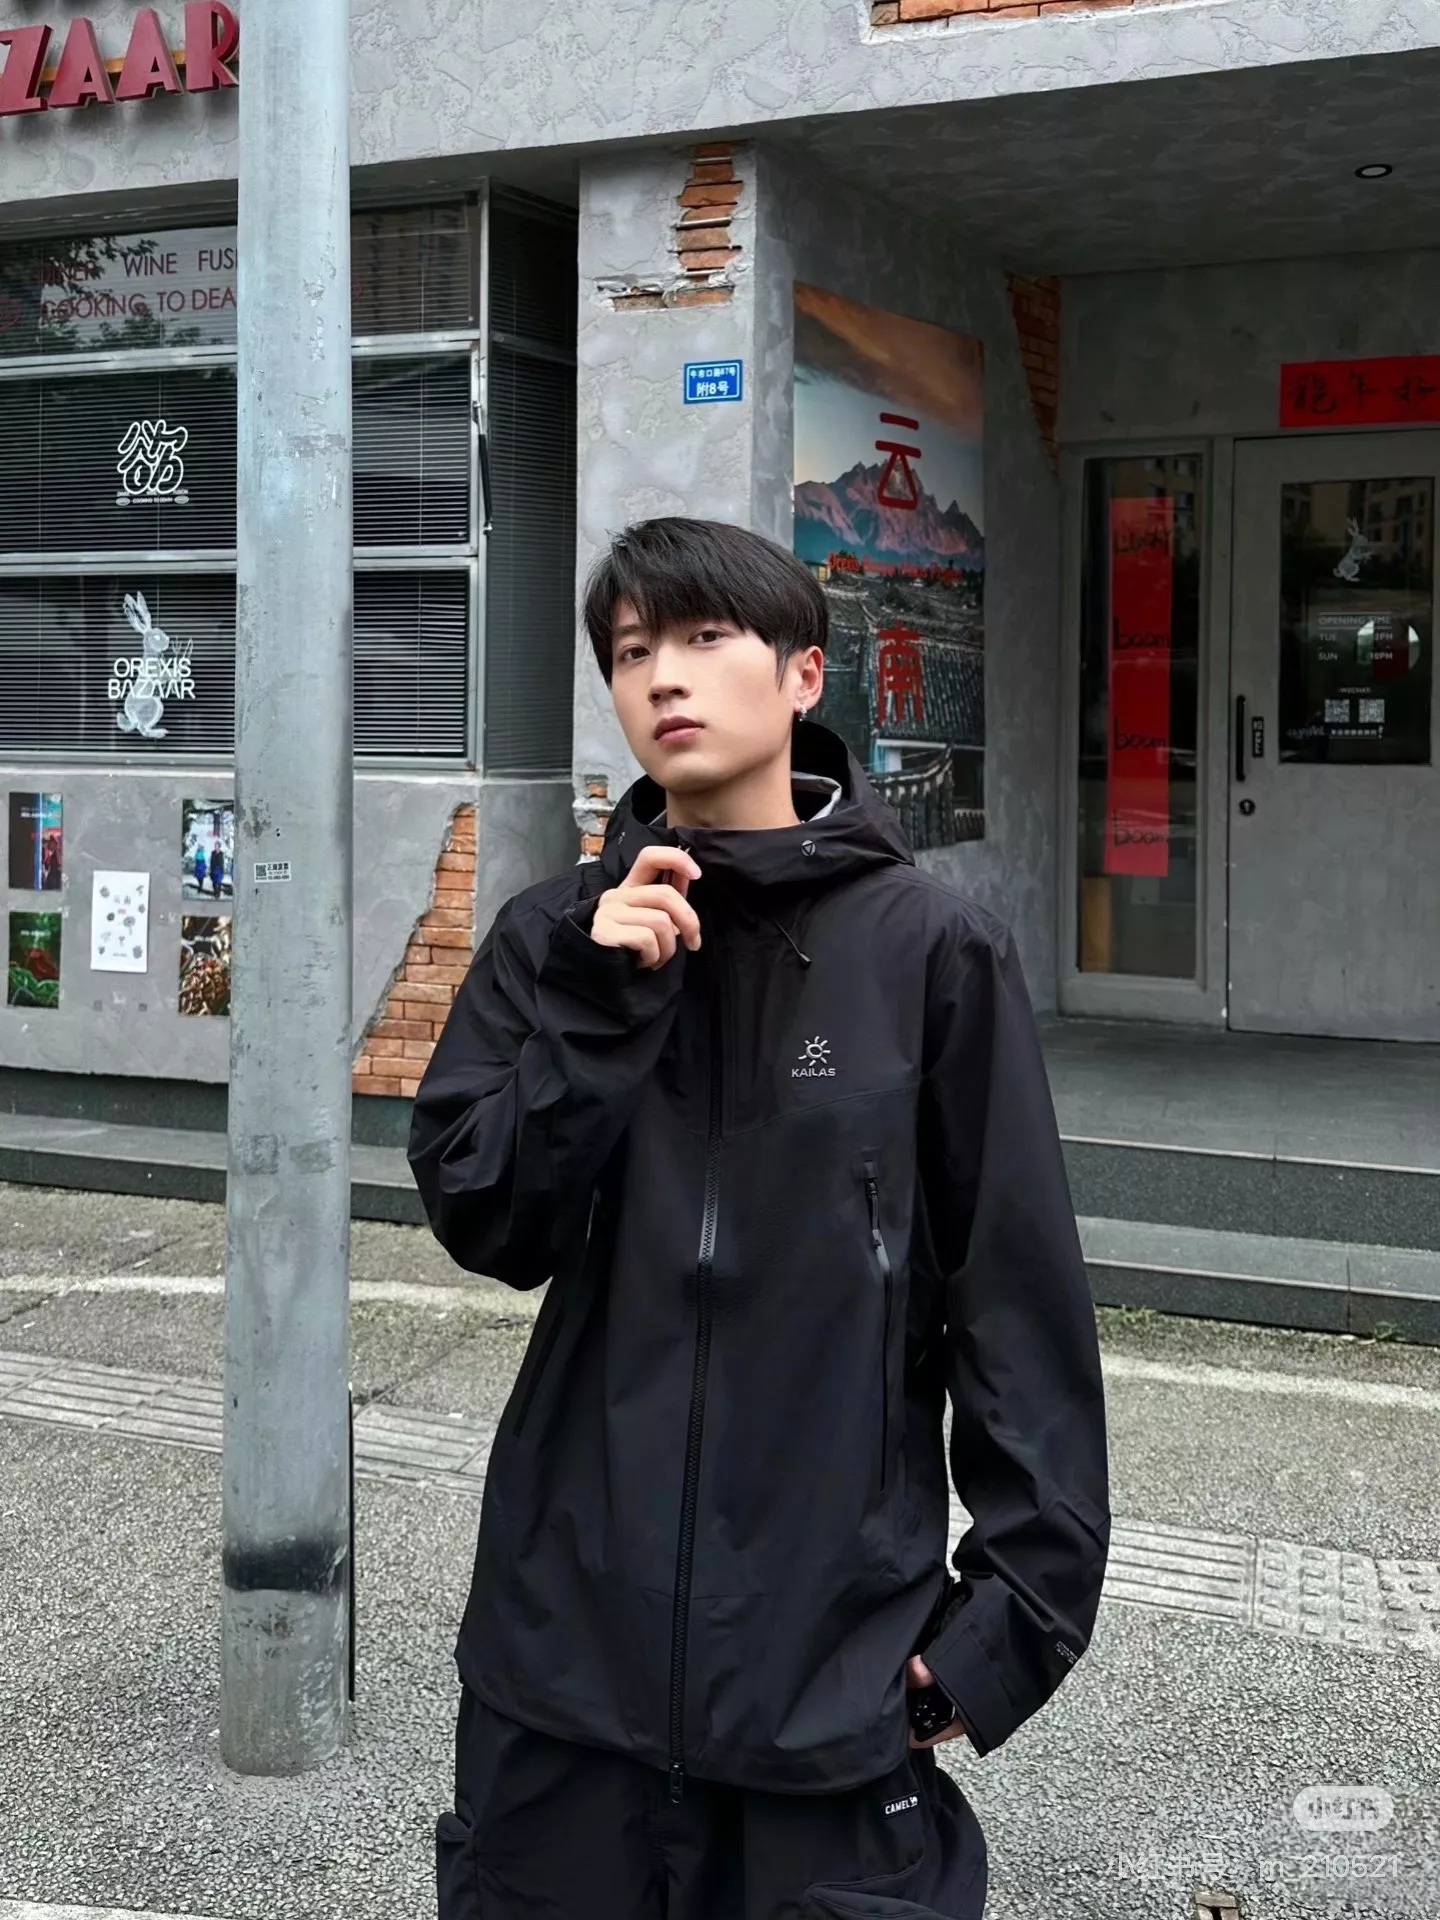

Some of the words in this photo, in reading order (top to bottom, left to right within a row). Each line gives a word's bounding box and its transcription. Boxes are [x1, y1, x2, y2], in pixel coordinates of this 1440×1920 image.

[0, 0, 240, 117] ZAAR
[123, 252, 177, 277] WINE
[41, 293, 148, 322] COOKING
[157, 290, 185, 312] TO
[696, 380, 729, 397] 附8号
[1318, 652, 1338, 660] SUN
[113, 657, 192, 678] OREXIS
[107, 678, 196, 699] BAZAAR
[791, 1068, 836, 1078] KAILAS
[885, 1799, 910, 1814] CAMEL
